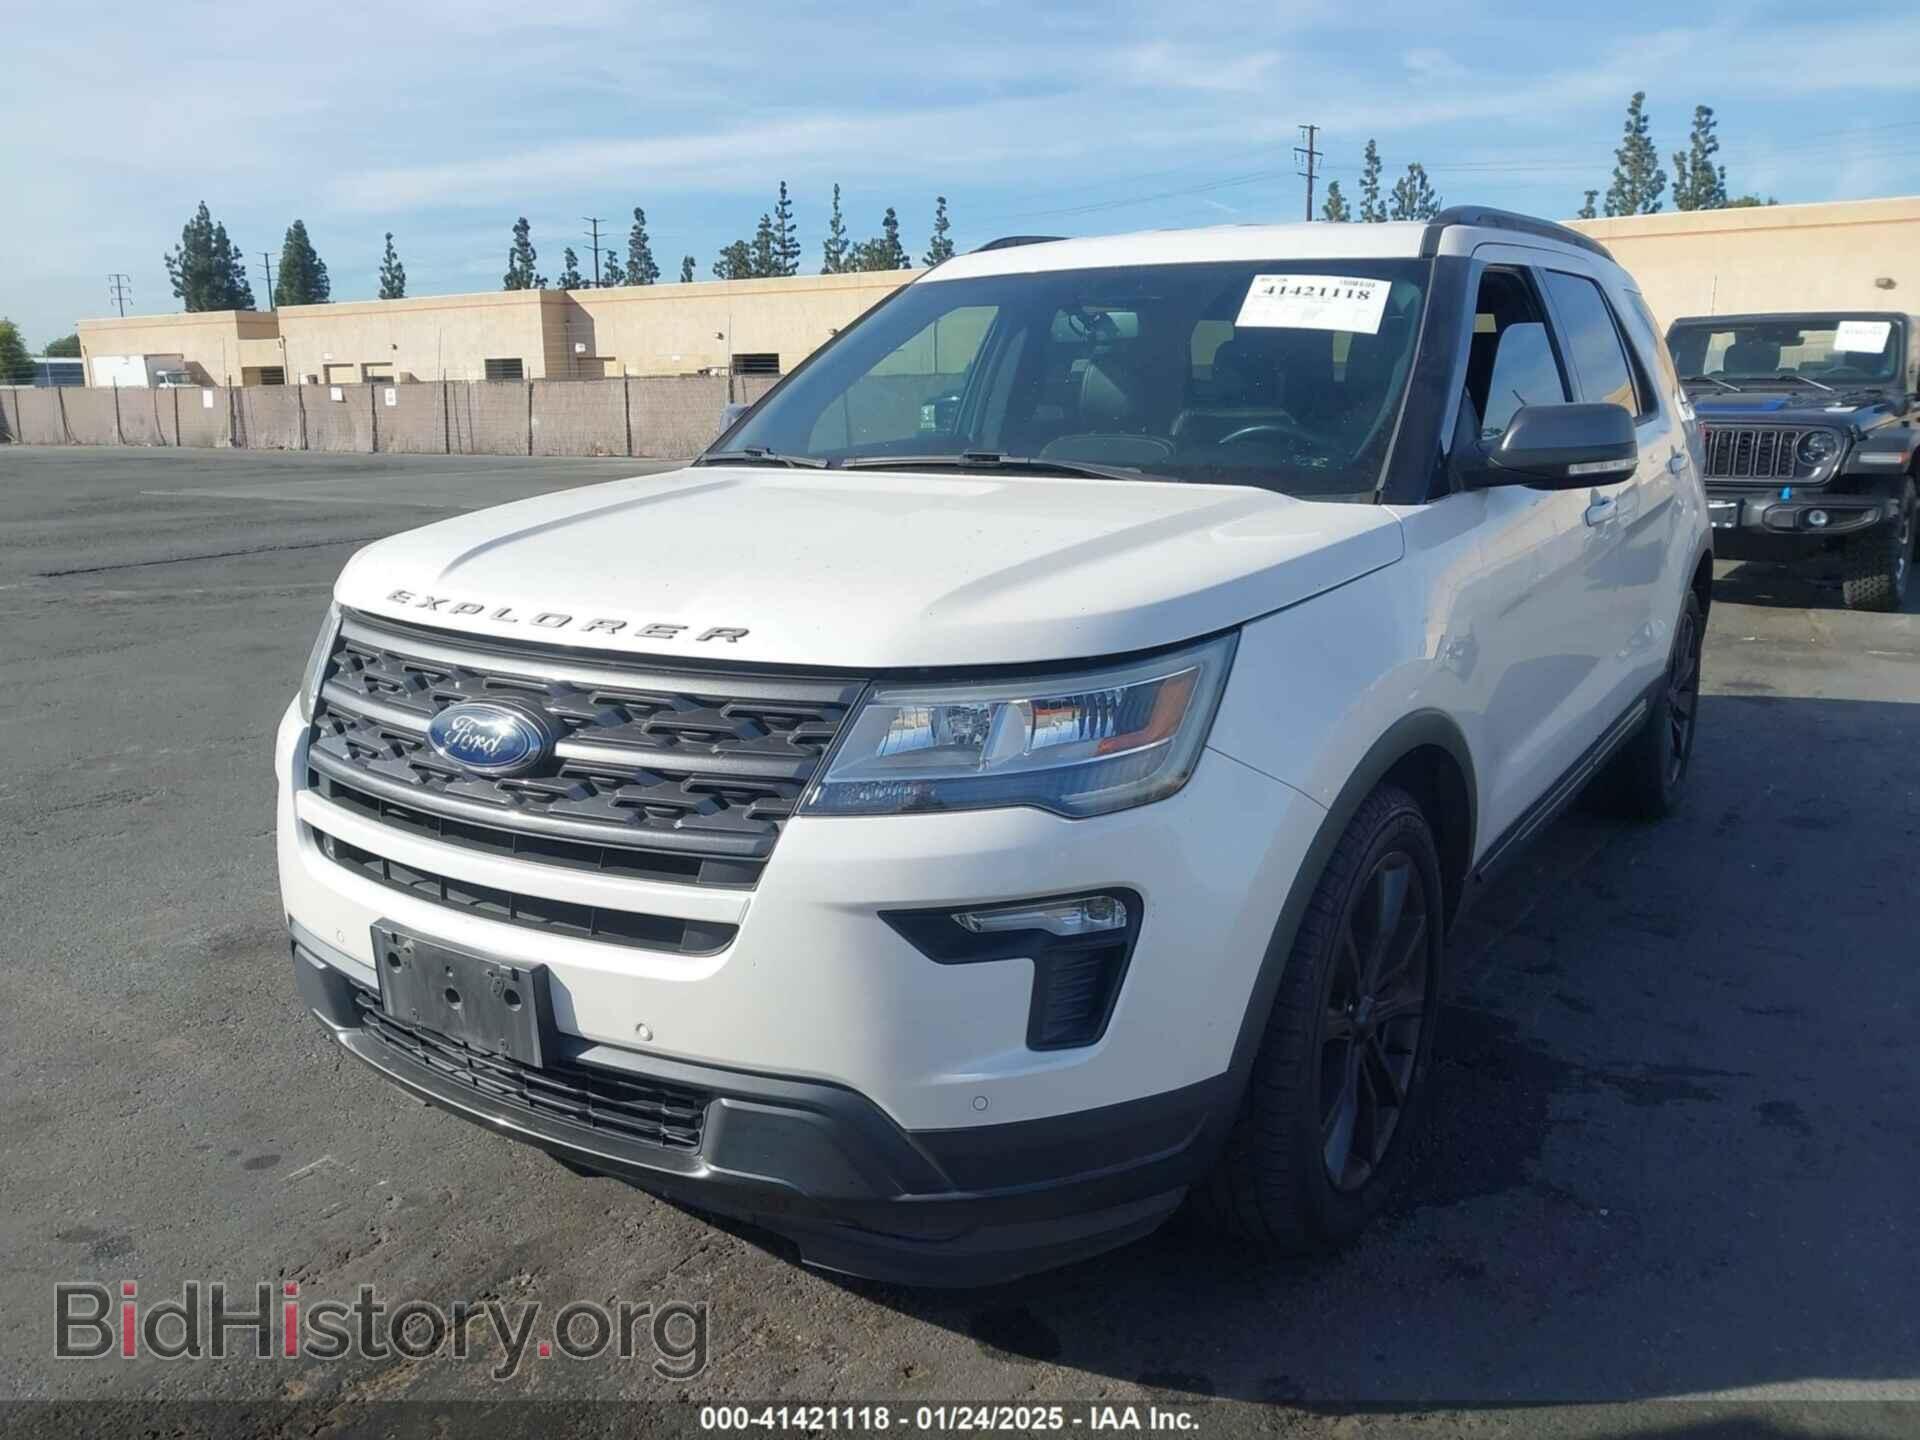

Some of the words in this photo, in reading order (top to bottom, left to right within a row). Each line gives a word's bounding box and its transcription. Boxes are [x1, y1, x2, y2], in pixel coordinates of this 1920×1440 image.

[1262, 285, 1371, 301] 41421118
[386, 588, 750, 643] EXPLORER
[444, 715, 510, 757] Ford
